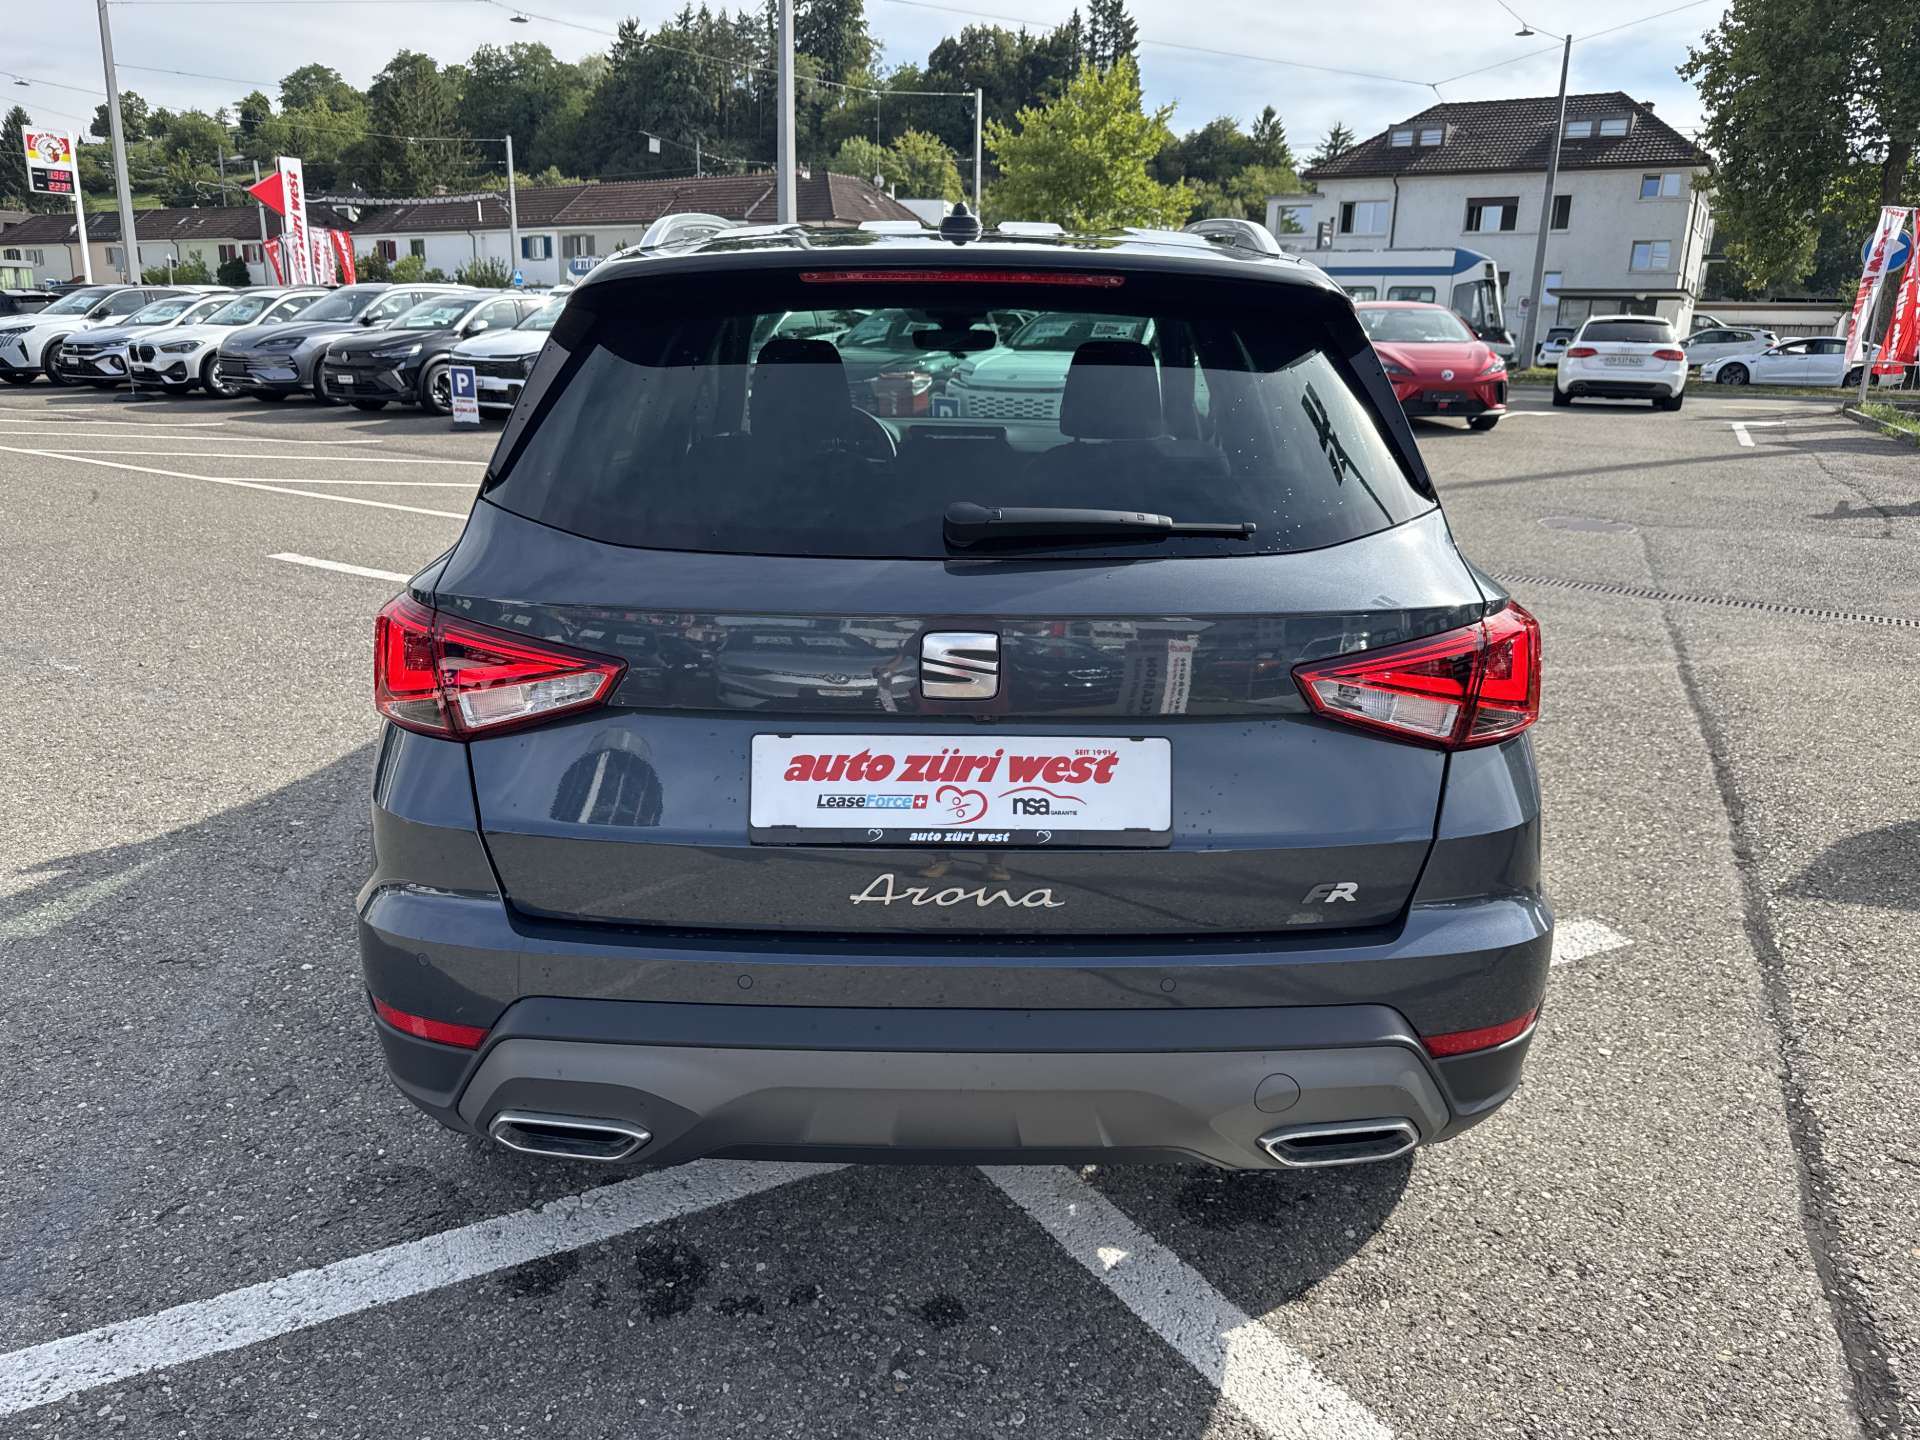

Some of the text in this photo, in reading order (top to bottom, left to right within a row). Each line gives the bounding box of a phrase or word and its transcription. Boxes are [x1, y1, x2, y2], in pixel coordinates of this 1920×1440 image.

[456, 373, 469, 394] P
[784, 748, 1120, 784] auto züri west
[816, 794, 913, 809] LeaseForce
[1012, 797, 1050, 815] nsa
[909, 831, 1011, 842] auto züri west
[849, 873, 1065, 908] Arona
[1302, 882, 1359, 904] FR
